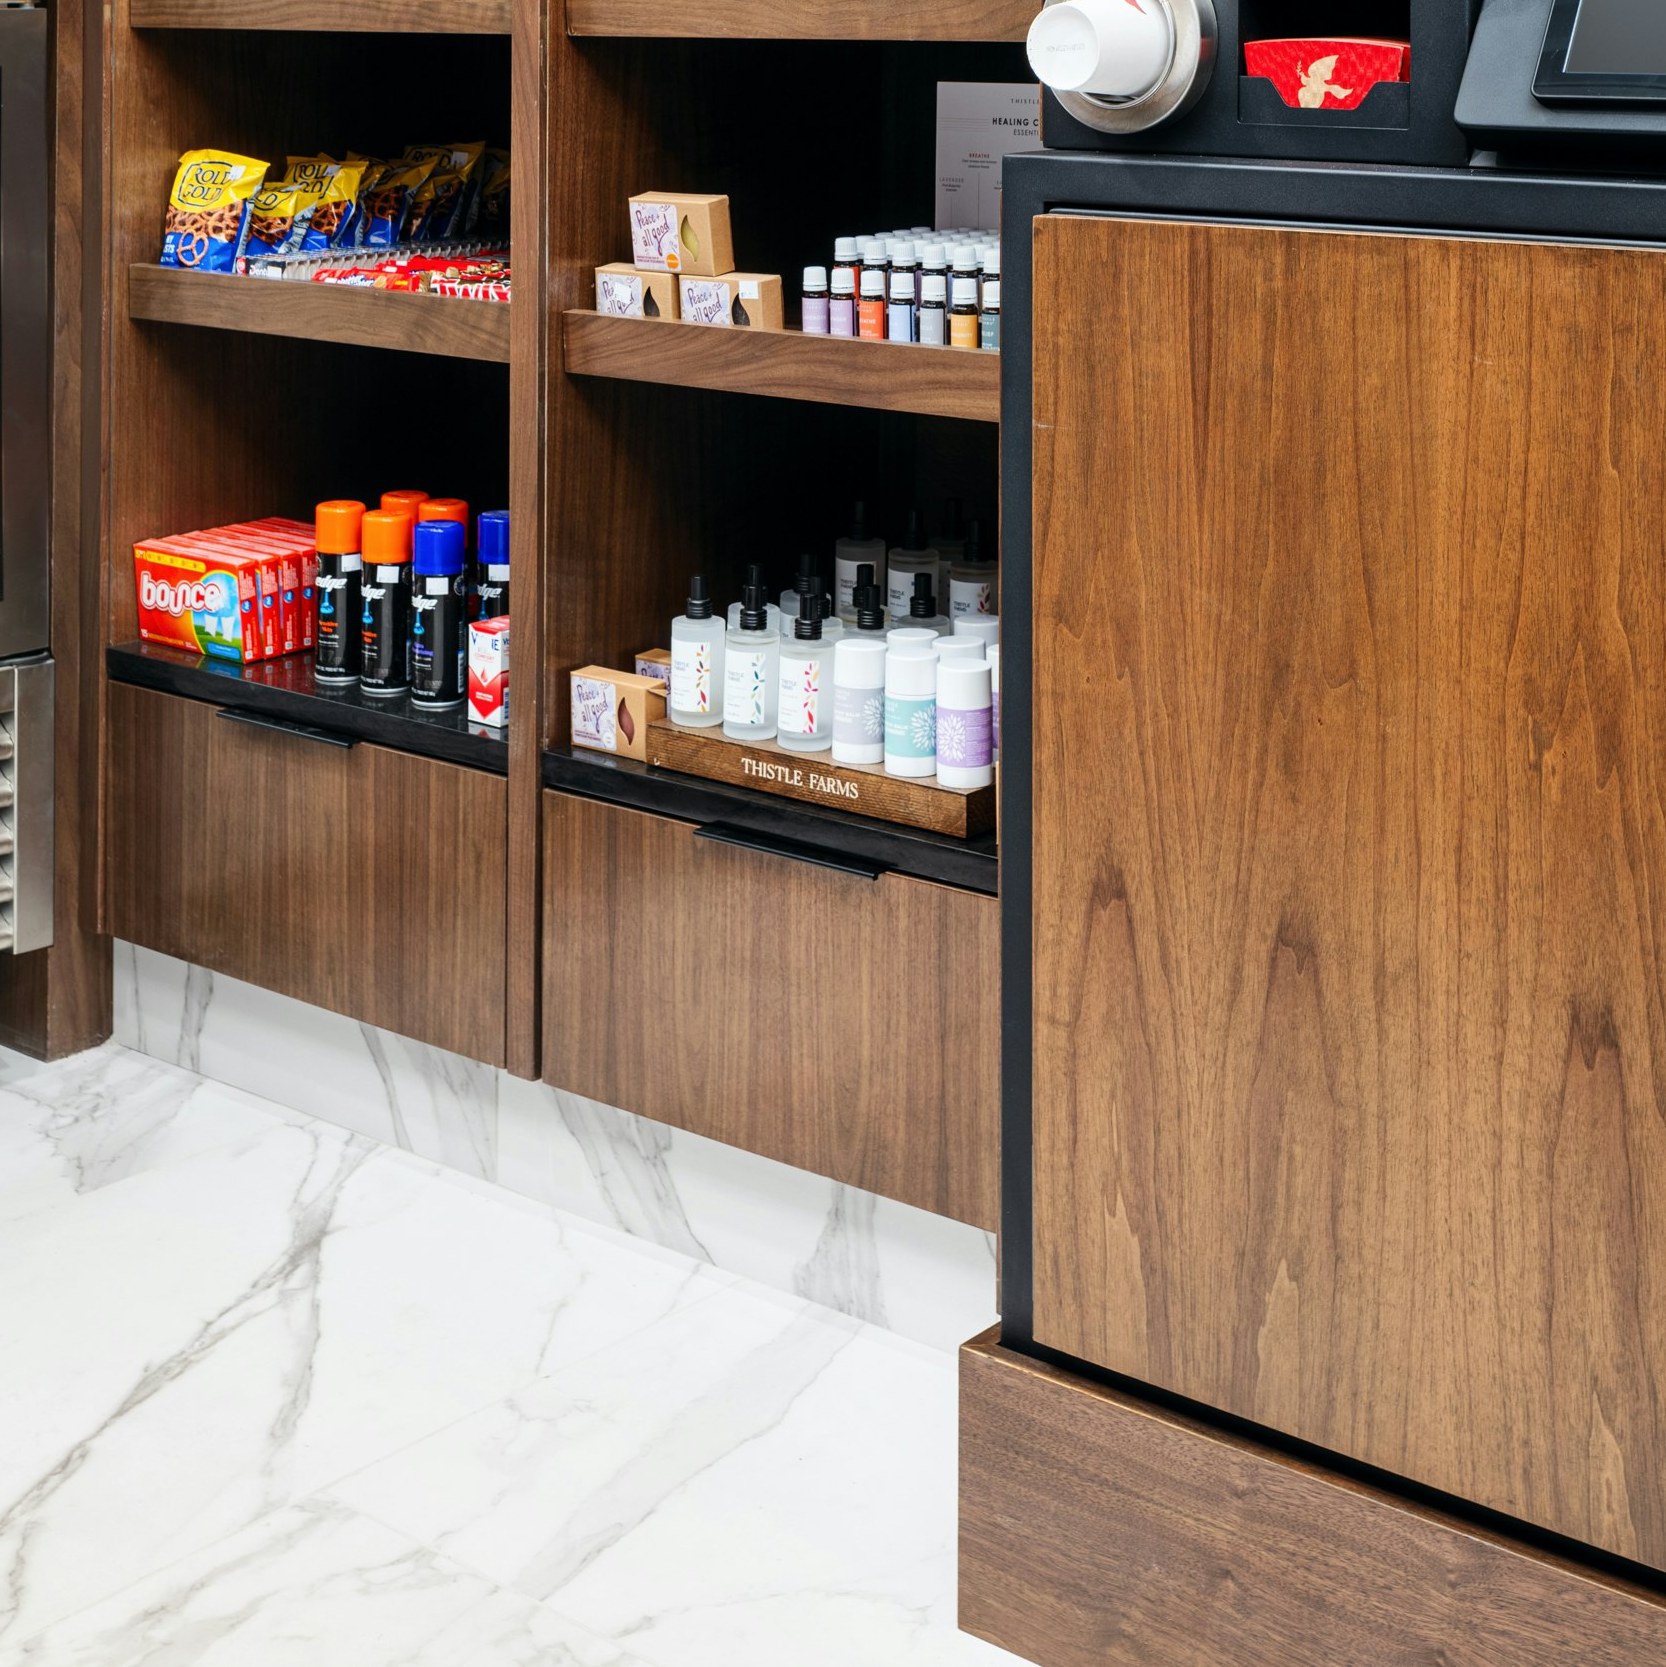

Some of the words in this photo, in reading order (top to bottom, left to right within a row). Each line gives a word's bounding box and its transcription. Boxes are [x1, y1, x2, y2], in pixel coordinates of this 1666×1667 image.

[992, 117, 1030, 127] HEALING
[194, 165, 233, 185] ROLD
[939, 176, 965, 184] LAVENDER
[183, 186, 223, 204] GOLD
[635, 209, 657, 230] Peace
[641, 228, 654, 247] all
[651, 213, 671, 257] good
[687, 287, 709, 308] Peace
[703, 292, 722, 323] good
[141, 570, 221, 618] bounce
[315, 574, 348, 593] edge
[141, 628, 149, 638] 15
[576, 683, 597, 704] Peace
[581, 703, 592, 722] all
[590, 691, 609, 735] good
[740, 756, 804, 788] THISTLE
[809, 770, 859, 800] FARMS
